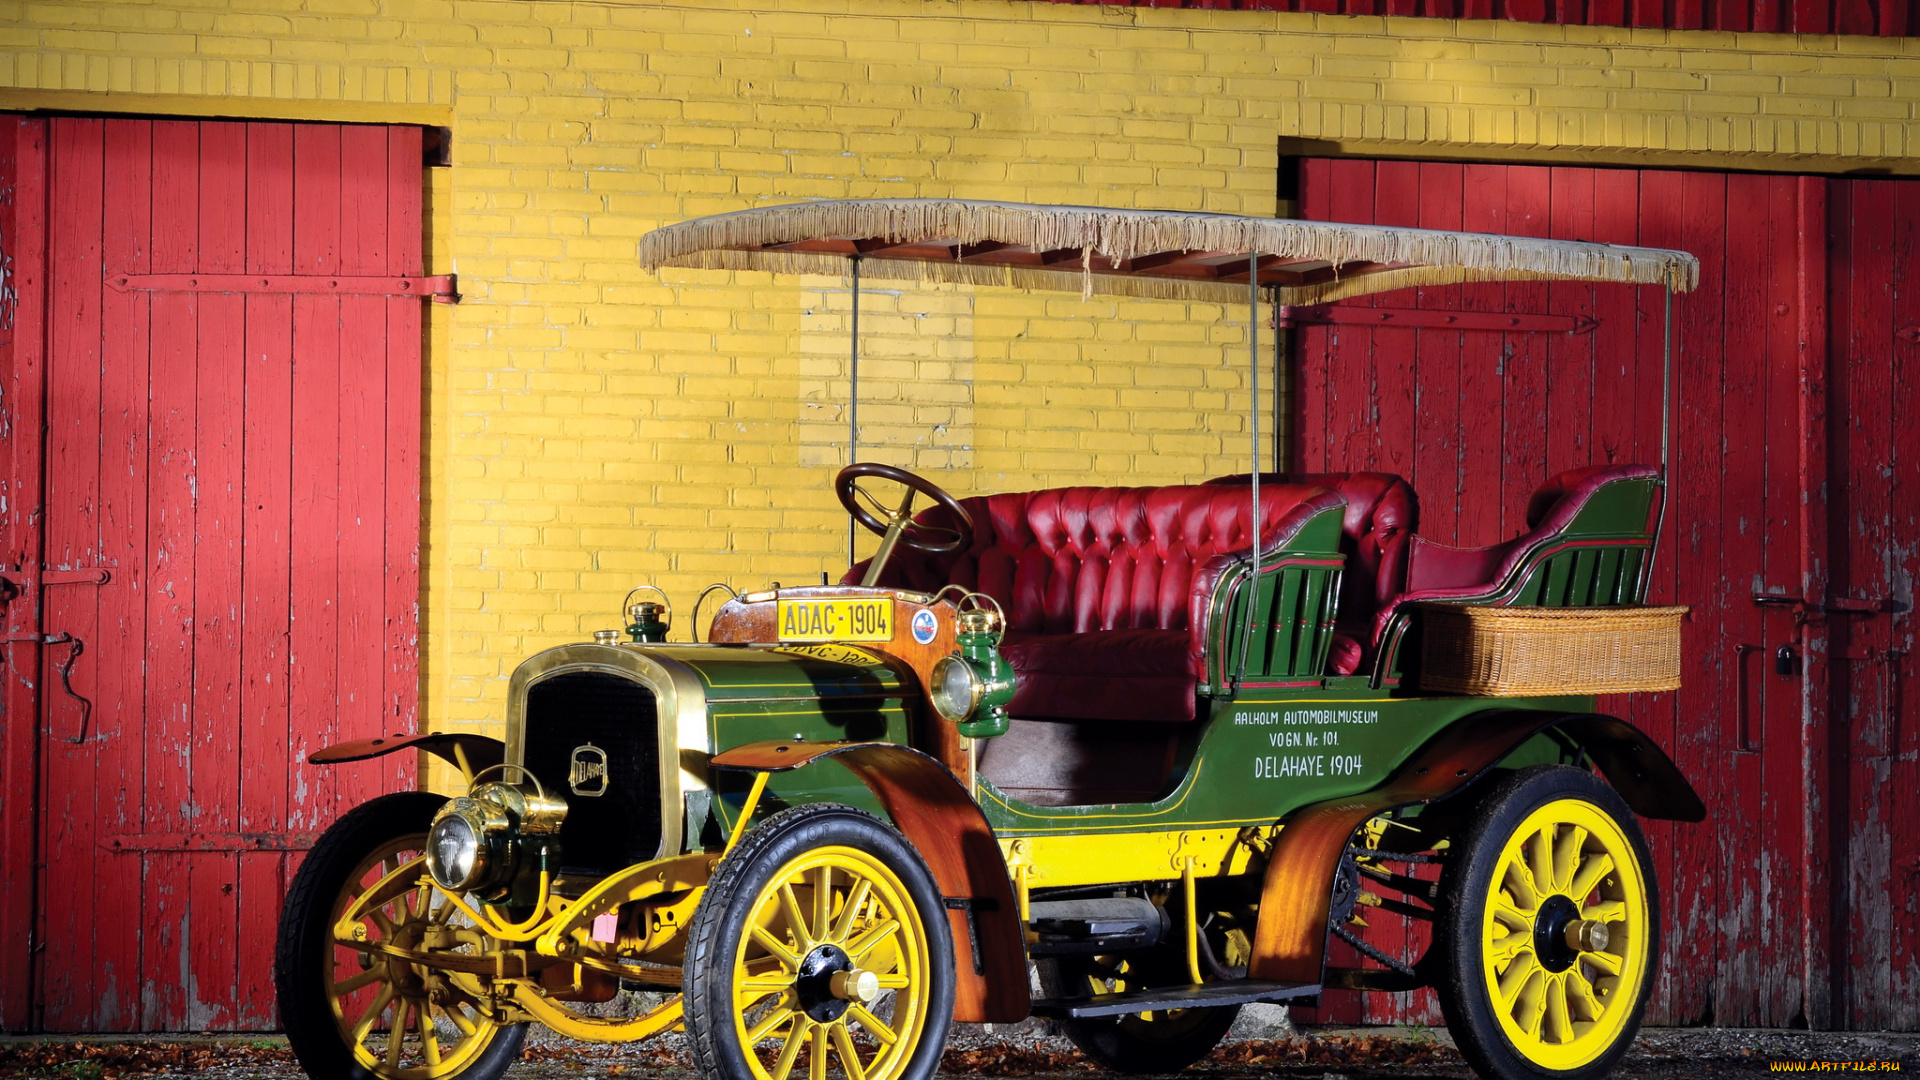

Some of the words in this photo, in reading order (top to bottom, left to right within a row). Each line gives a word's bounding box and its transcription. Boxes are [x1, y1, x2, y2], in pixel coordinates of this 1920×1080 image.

[1234, 711, 1279, 726] AALHOLM
[1283, 710, 1378, 725] AUTOMOBILMUSEUM
[1269, 732, 1303, 747] VOGN.
[1255, 755, 1324, 778] DELAHAYE
[1330, 754, 1362, 776] 1904
